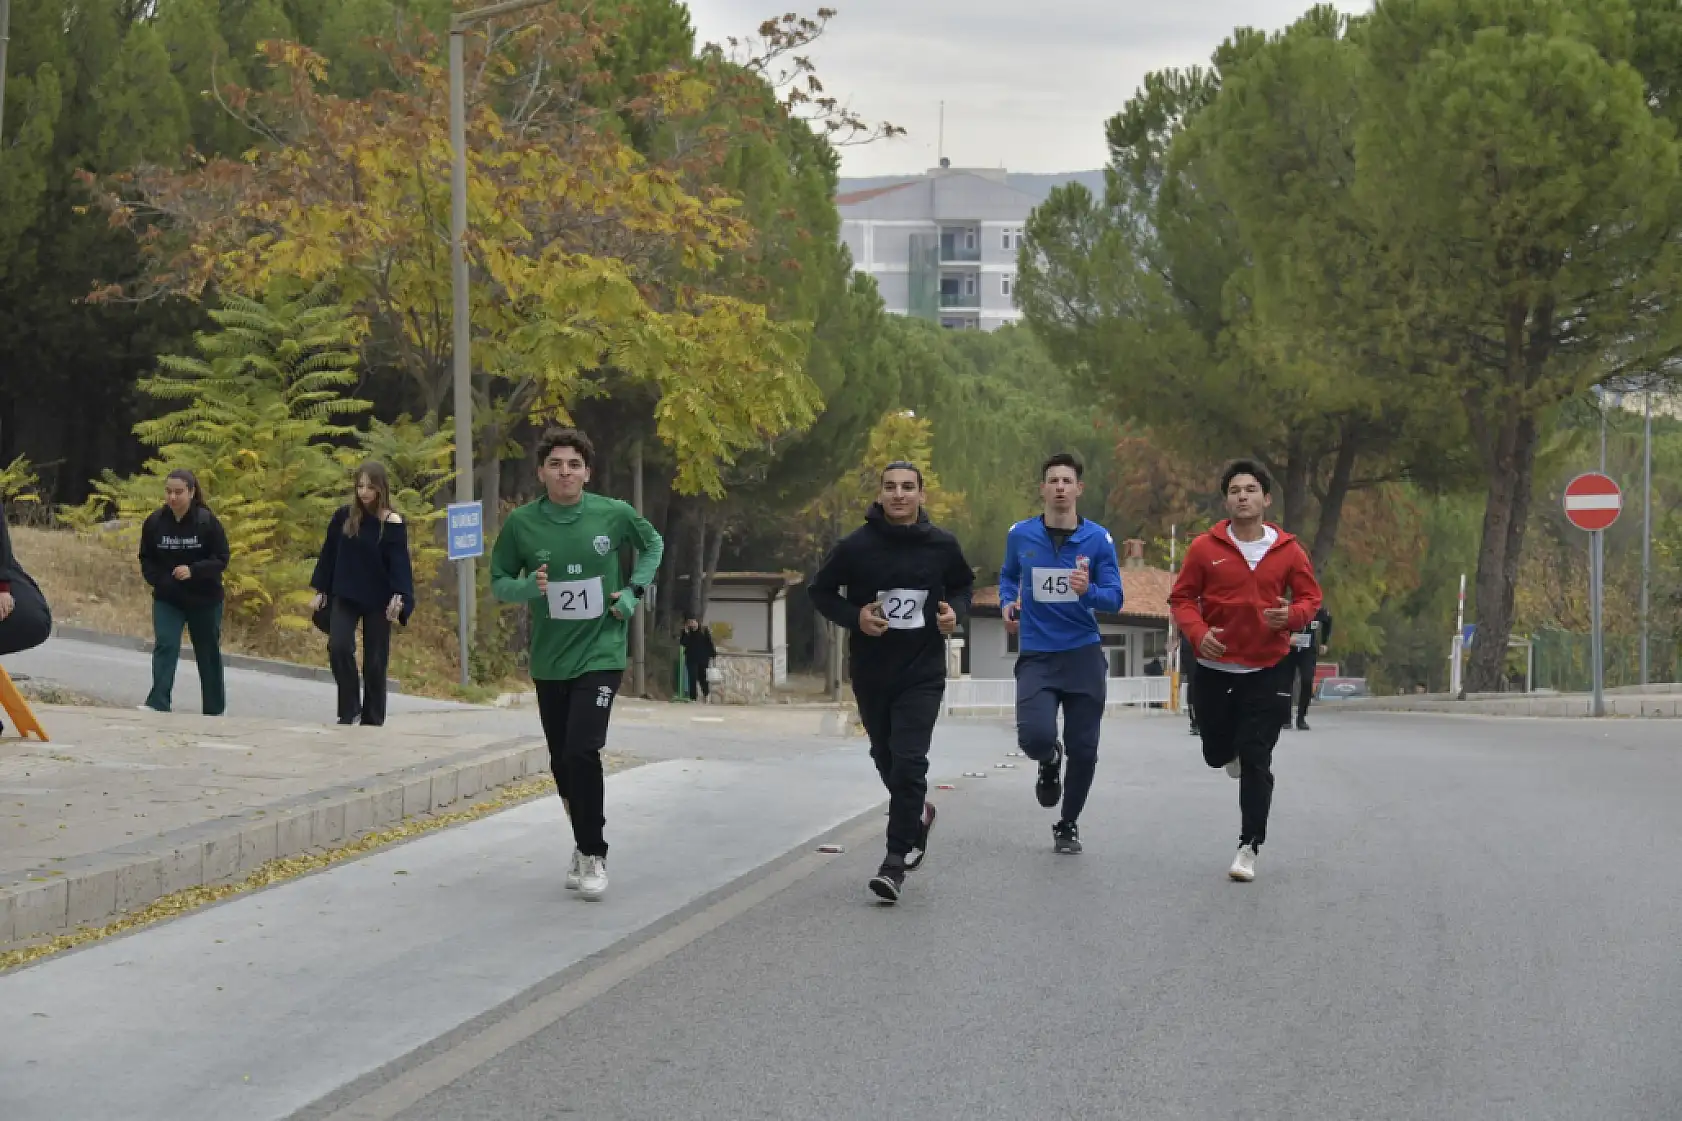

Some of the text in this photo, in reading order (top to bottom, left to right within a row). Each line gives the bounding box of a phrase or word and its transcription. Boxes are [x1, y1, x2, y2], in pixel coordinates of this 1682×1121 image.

[567, 564, 582, 574] 88
[1042, 576, 1068, 594] 45
[560, 588, 588, 611] 21
[889, 597, 916, 620] 22
